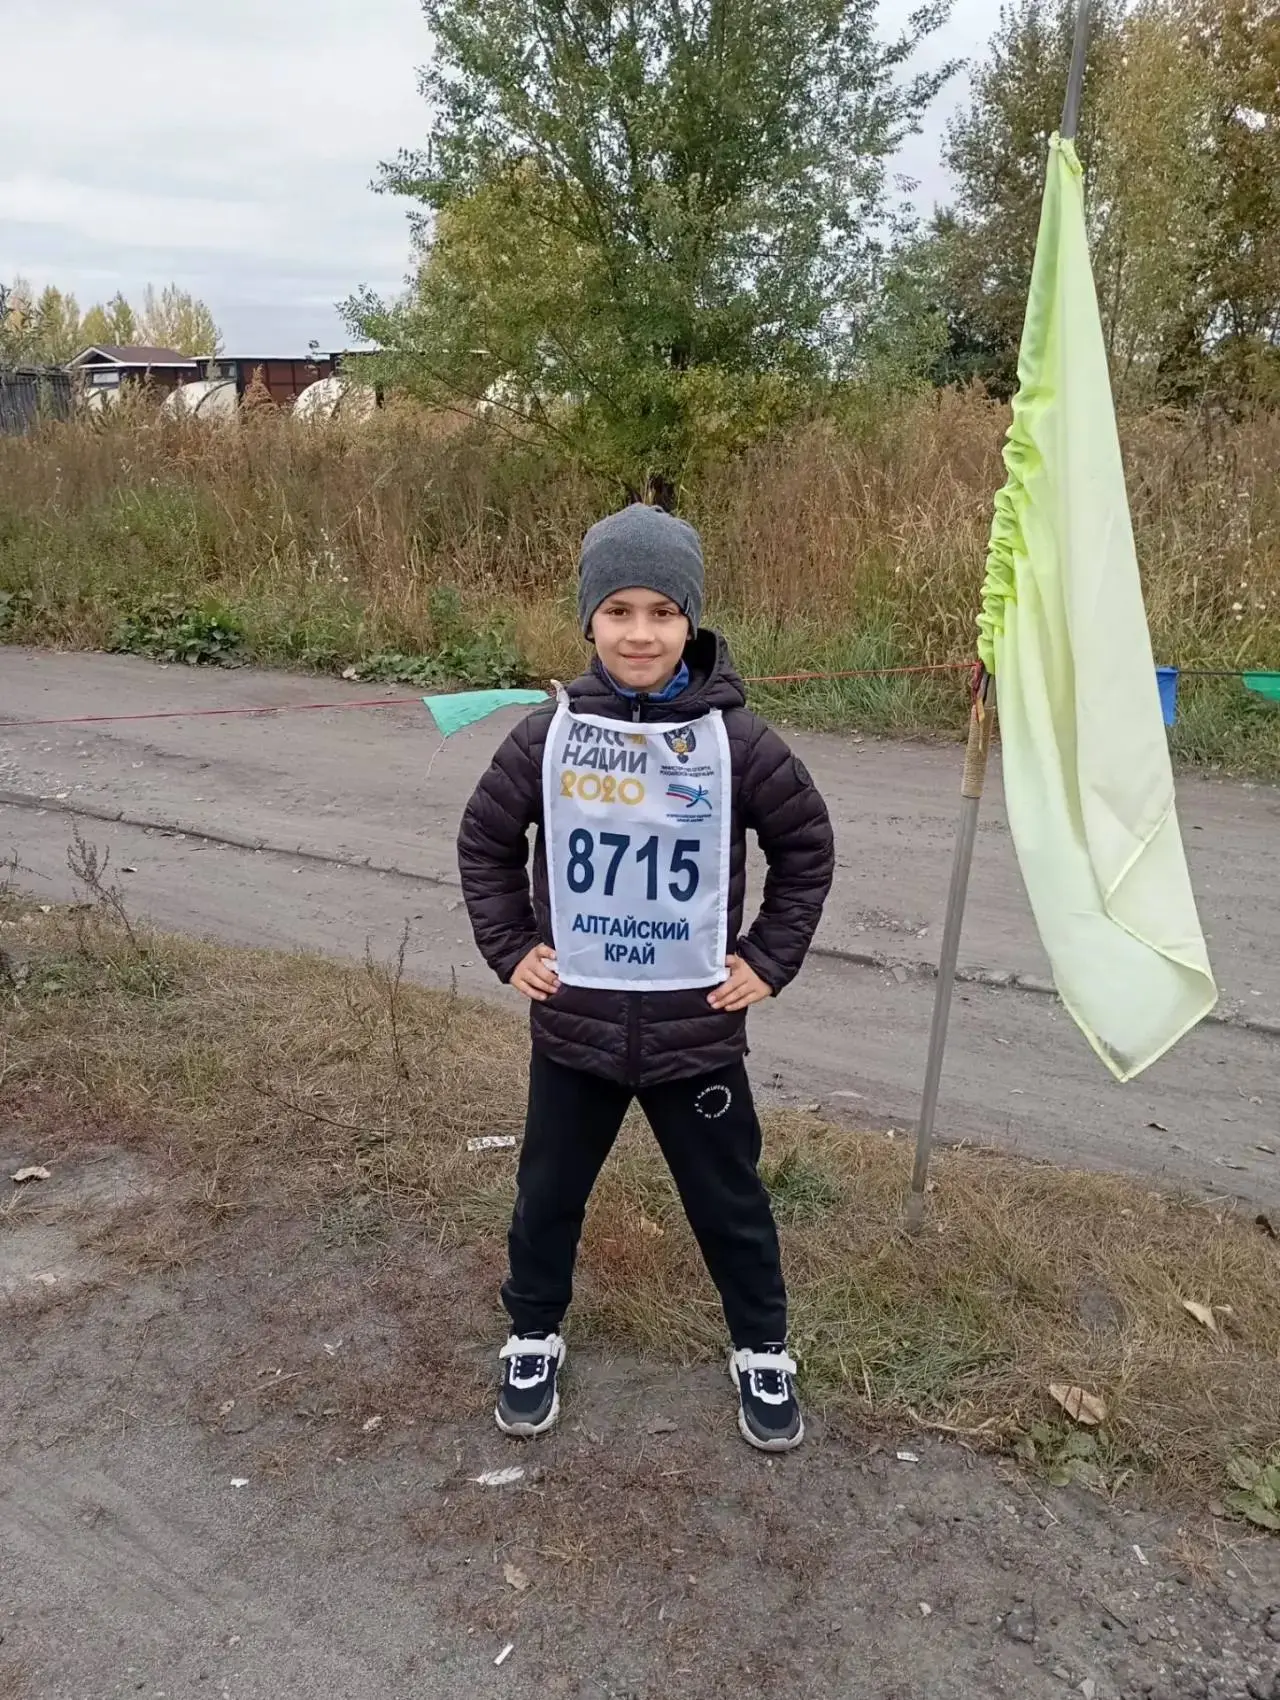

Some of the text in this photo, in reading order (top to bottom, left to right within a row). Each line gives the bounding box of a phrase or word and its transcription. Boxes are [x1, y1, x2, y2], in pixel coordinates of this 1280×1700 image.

[561, 743, 648, 774] НАЦИИ
[560, 769, 645, 806] 2020
[566, 828, 701, 902] 8715
[571, 913, 690, 941] АЛТАЙСКИЙ
[604, 942, 656, 965] КРАЙ
